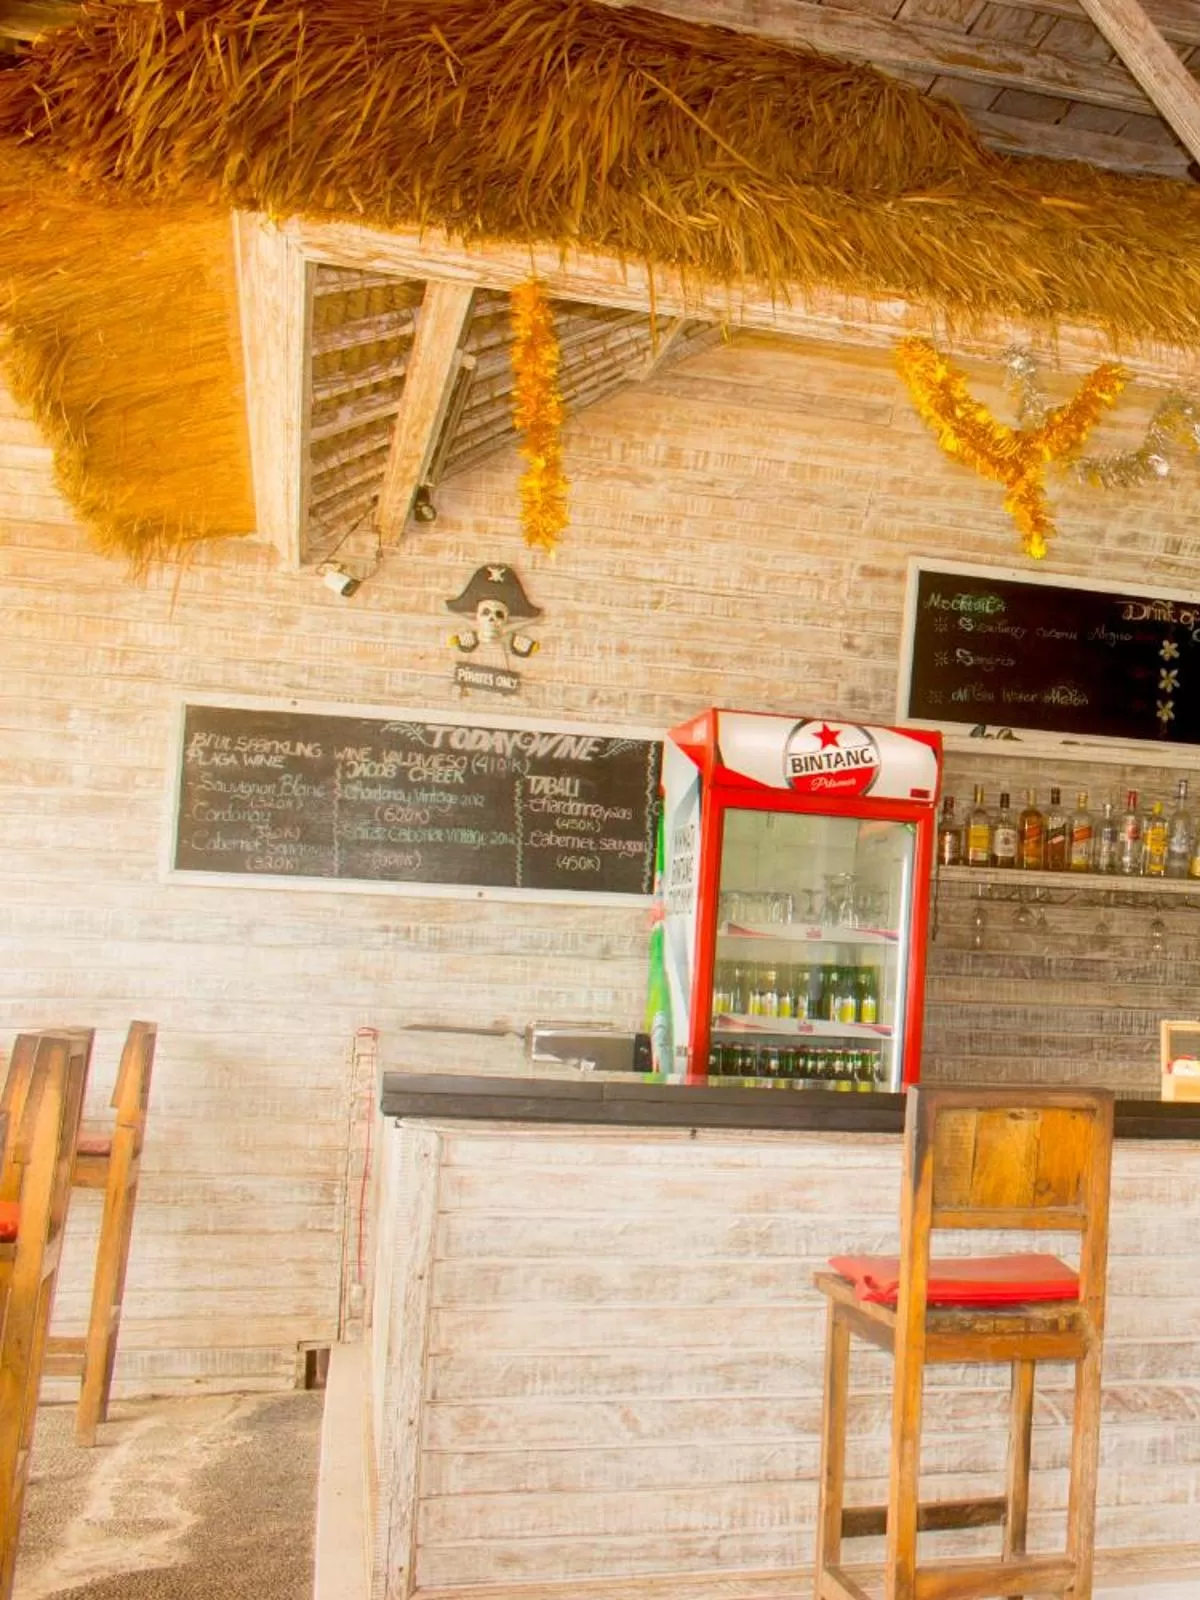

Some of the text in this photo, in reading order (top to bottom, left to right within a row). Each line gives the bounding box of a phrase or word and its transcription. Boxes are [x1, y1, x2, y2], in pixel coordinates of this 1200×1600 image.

[1117, 600, 1177, 624] Drink
[1180, 611, 1200, 630] of
[525, 730, 604, 762] WINE
[791, 747, 874, 775] BINTANG
